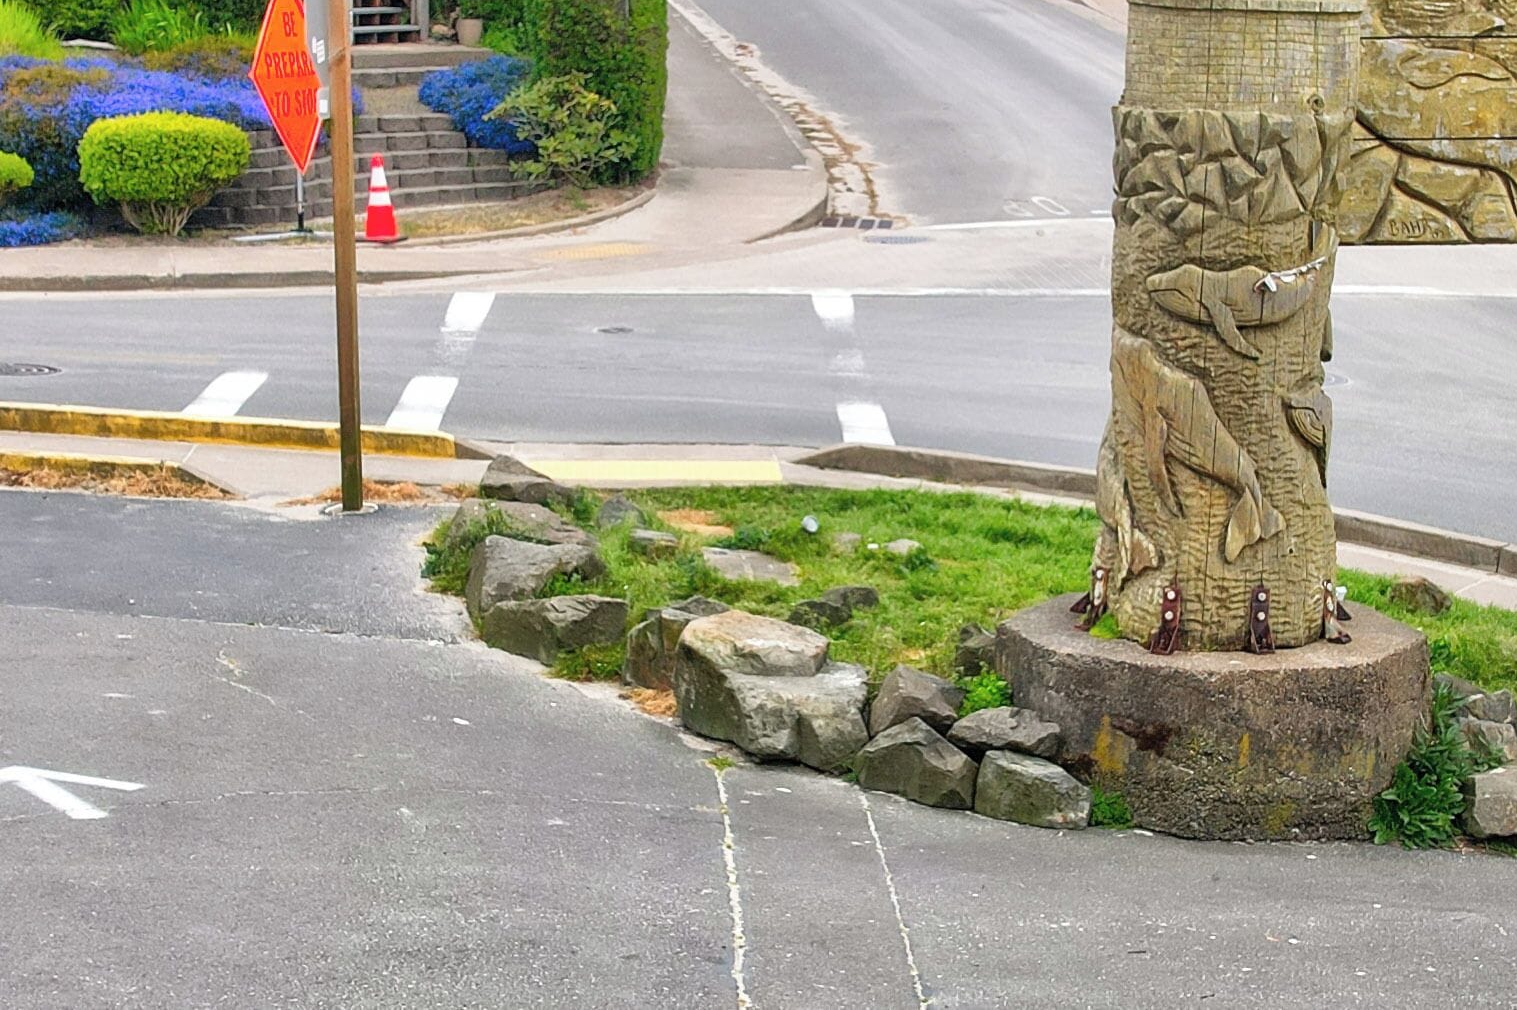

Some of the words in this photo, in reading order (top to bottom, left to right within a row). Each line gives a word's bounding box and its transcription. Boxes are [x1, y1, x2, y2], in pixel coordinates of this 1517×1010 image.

[282, 11, 298, 37] BE
[264, 50, 316, 80] PREPAR
[274, 90, 290, 119] TO
